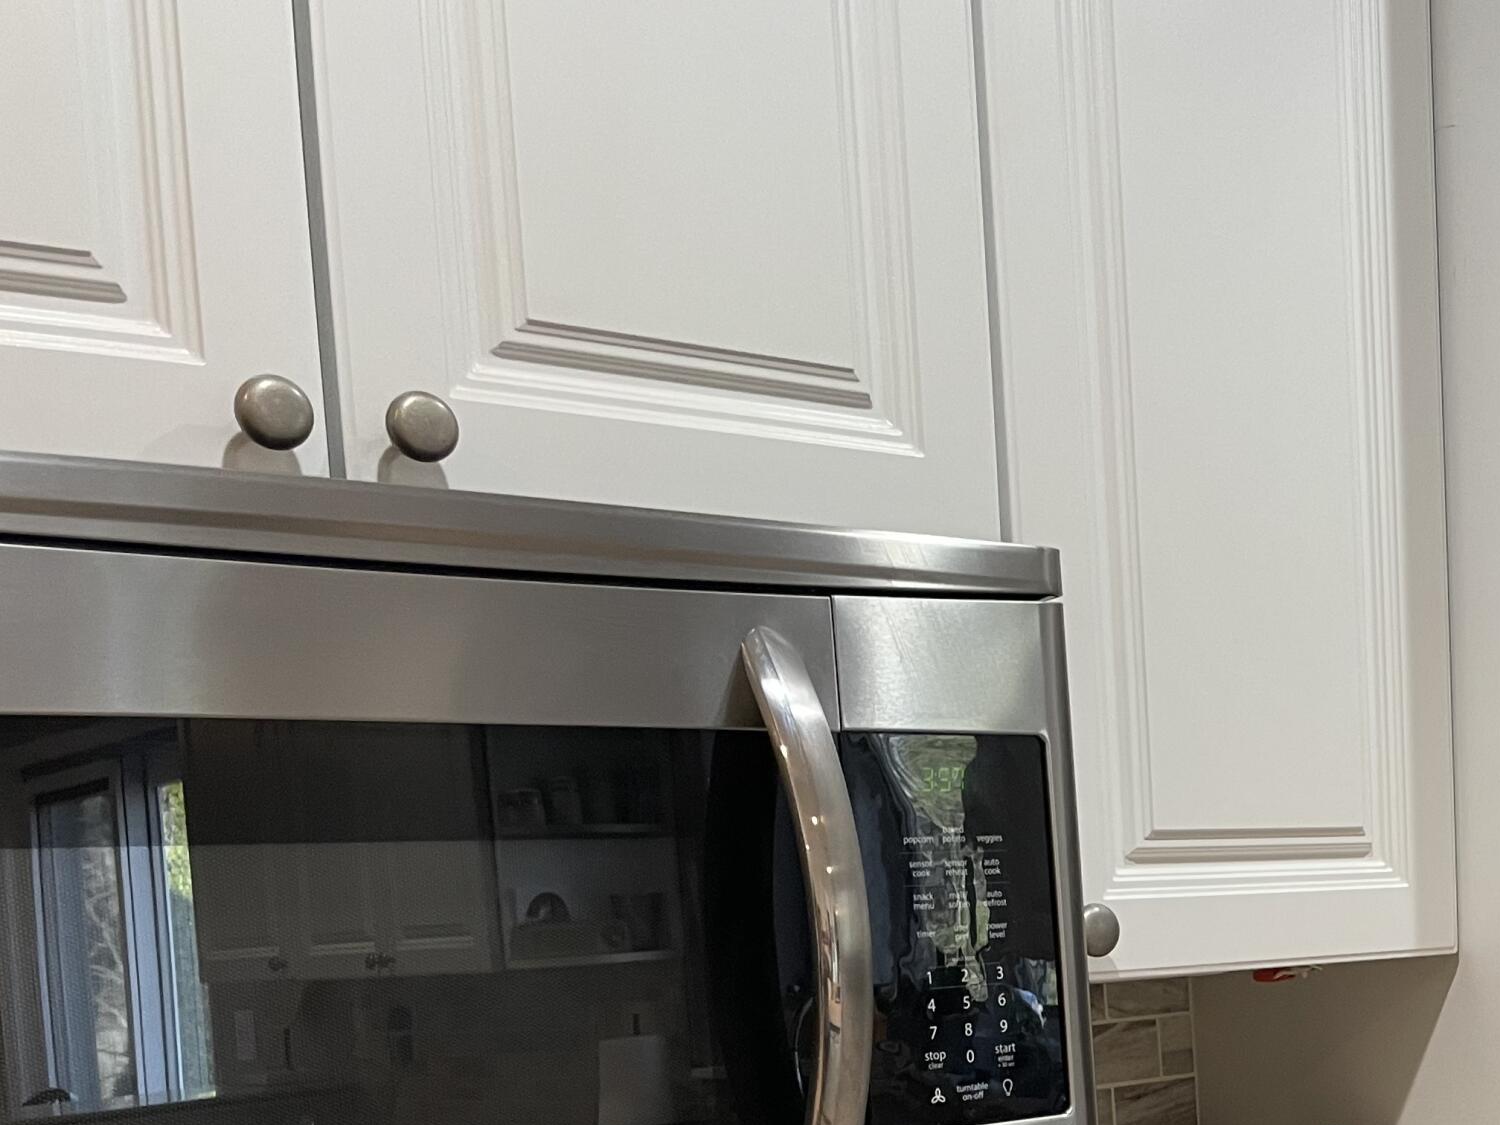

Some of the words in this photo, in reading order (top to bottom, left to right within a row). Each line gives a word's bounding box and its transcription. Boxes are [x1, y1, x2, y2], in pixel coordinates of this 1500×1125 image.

[983, 858, 1000, 867] auto
[984, 867, 1001, 876] cook
[926, 970, 933, 985] 1
[961, 968, 968, 983] 2
[996, 966, 1004, 980] 3
[927, 998, 936, 1012] 4
[963, 995, 971, 1010] 5
[998, 992, 1007, 1006] 6
[929, 1025, 938, 1041] 7
[964, 1022, 973, 1037] 8
[1000, 1019, 1008, 1033] 9
[924, 1050, 947, 1062] stop
[966, 1049, 975, 1064] 0
[994, 1043, 1016, 1055] start
[956, 1081, 989, 1093] turntable
